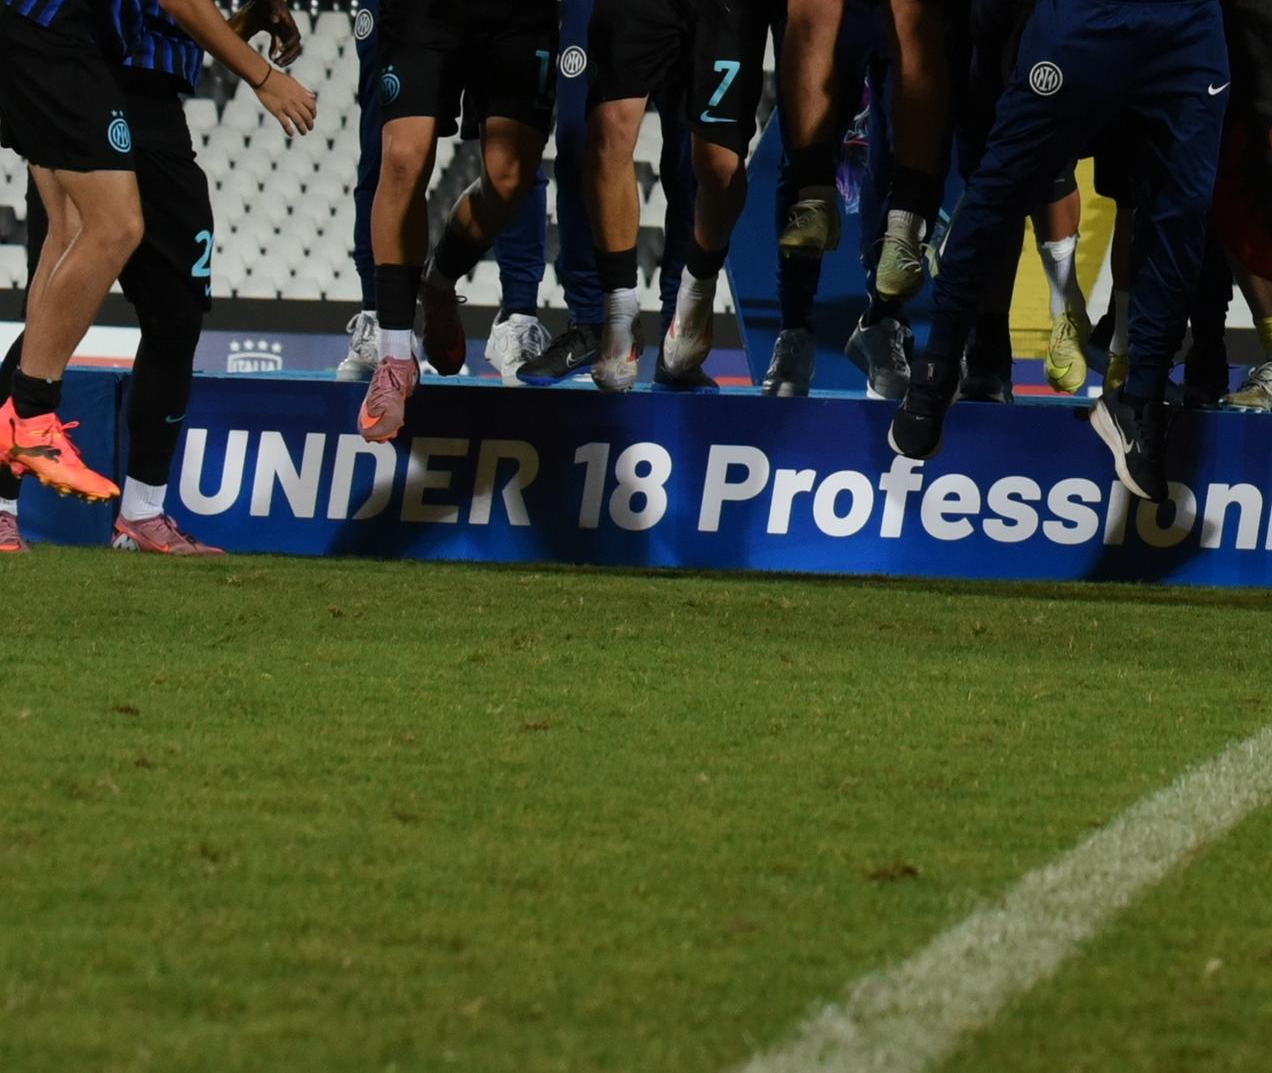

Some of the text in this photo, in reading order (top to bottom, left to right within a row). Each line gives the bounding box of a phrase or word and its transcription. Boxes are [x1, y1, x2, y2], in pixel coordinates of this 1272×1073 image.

[709, 59, 742, 108] 7
[178, 427, 541, 527] UNDER
[572, 440, 673, 532] 18
